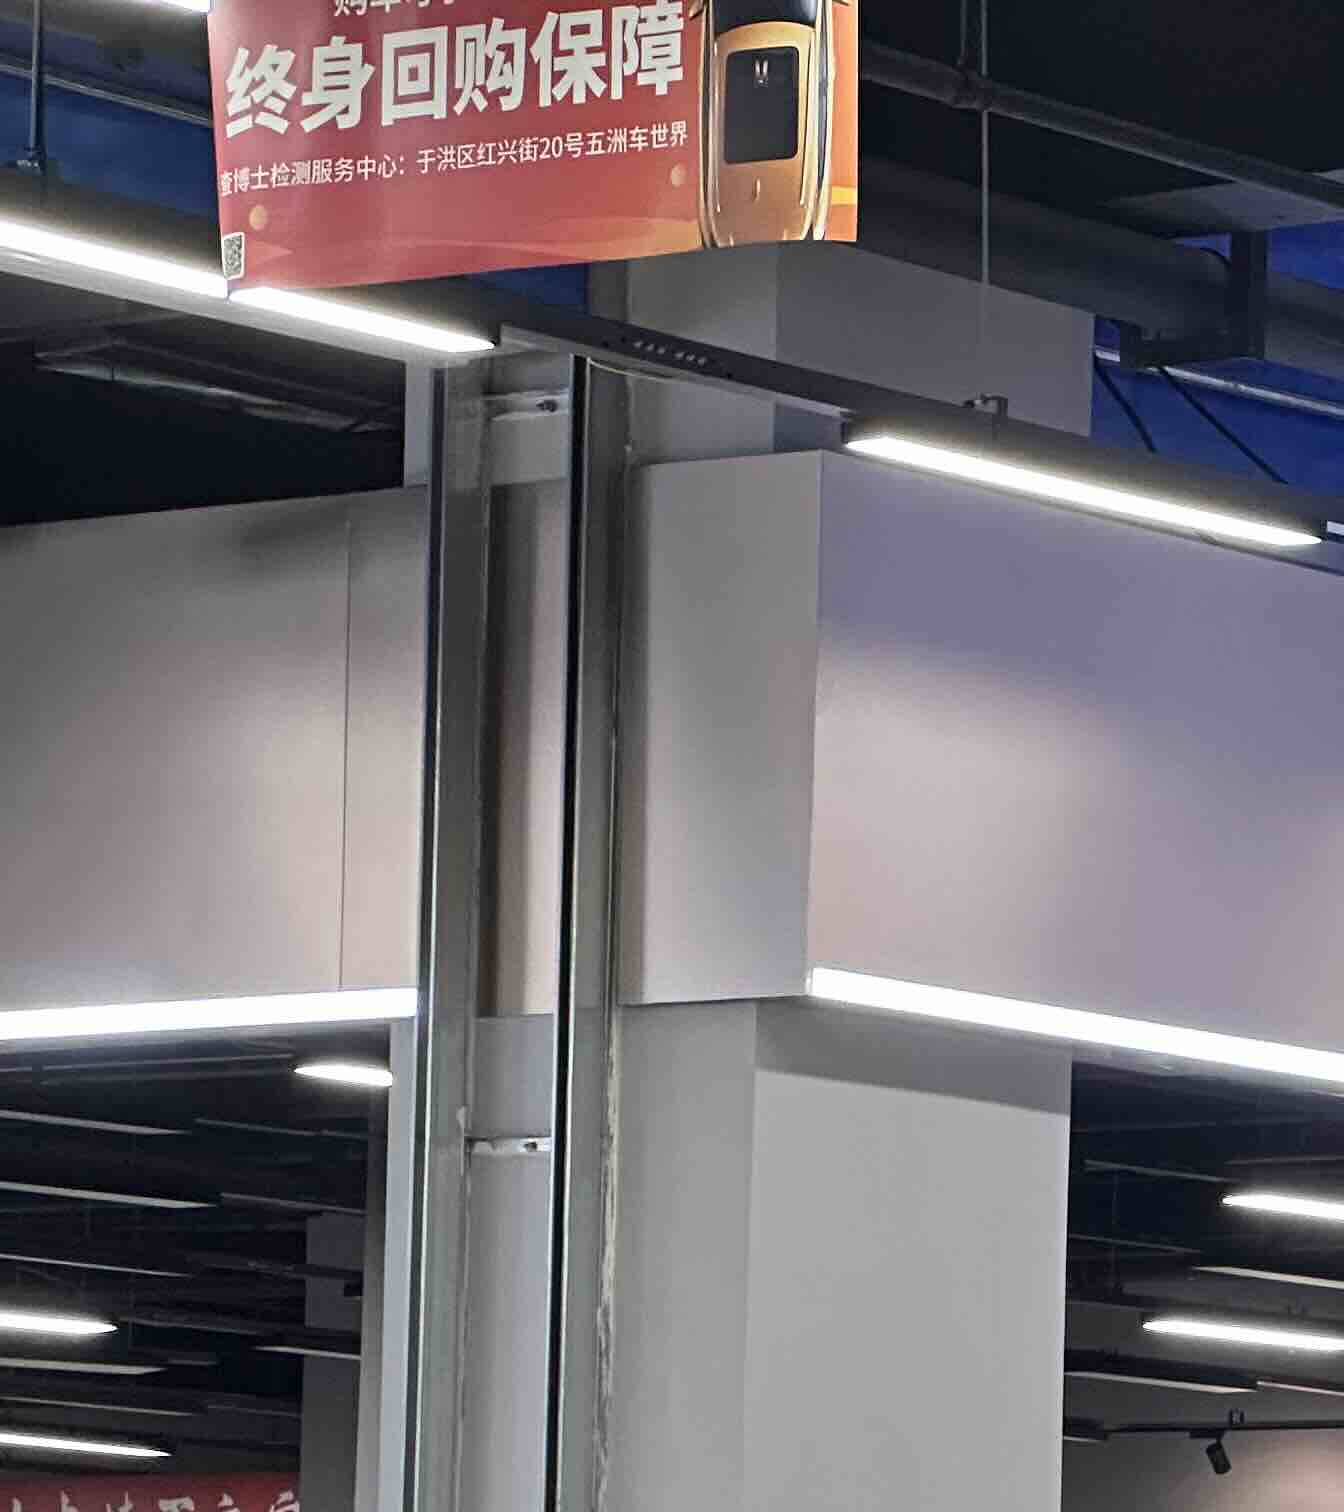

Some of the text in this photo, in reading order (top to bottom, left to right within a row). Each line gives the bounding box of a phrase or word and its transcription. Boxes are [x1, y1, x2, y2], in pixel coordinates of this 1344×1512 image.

[225, 1, 684, 138] 终身回购保障
